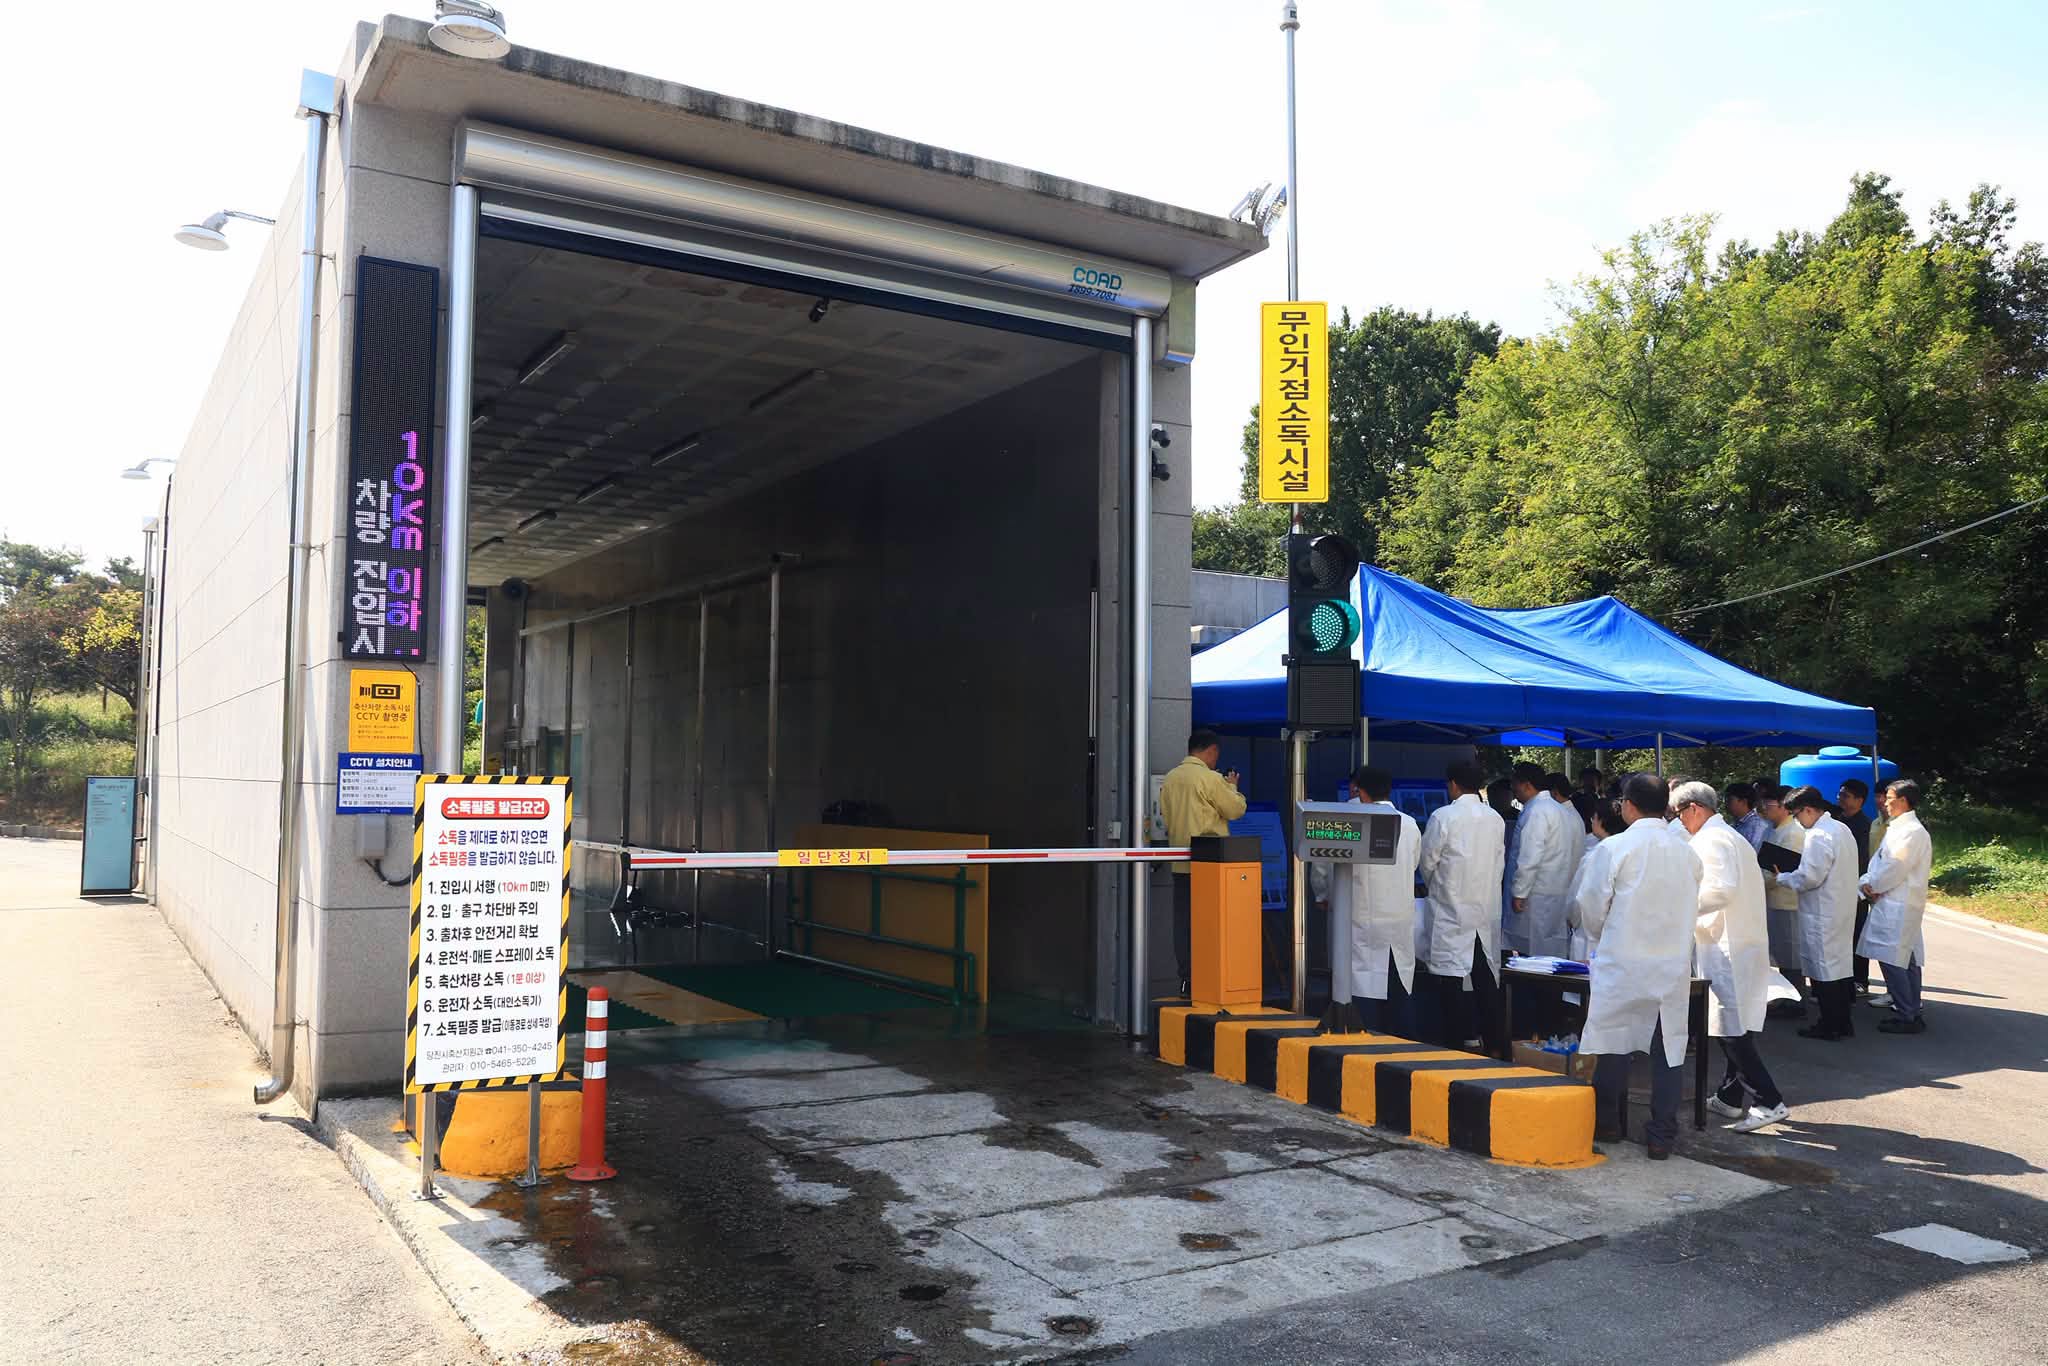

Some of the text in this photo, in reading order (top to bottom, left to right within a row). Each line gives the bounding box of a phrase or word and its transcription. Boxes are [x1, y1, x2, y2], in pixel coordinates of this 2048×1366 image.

[1073, 266, 1122, 290] COAD
[1278, 311, 1312, 492] 무인거점소독시설
[350, 478, 392, 654] 차량 진입시
[386, 567, 422, 631] 이하
[354, 703, 381, 712] 축산차량
[356, 712, 408, 722] CCTV 촬영중
[350, 757, 413, 768] CCTV 설치안내
[447, 800, 545, 815] 소독필증 발급요건
[438, 830, 548, 845] 소독을 제대로 하지 않으면
[429, 850, 557, 866] 소독필증을 발급하지 않습니다.
[797, 850, 871, 864] 일단정지
[428, 882, 437, 894] 1.
[440, 880, 471, 895] 진입시
[474, 880, 496, 894] 서행
[530, 880, 550, 893] 미만)
[427, 905, 438, 918] 2.
[485, 902, 516, 917] 차단바
[518, 901, 538, 917] 주의
[426, 924, 539, 942] 3. 출차후 안전거리 확보
[425, 952, 435, 965] 4.
[495, 947, 533, 963] 스프레이
[536, 946, 555, 961] 소독
[425, 976, 436, 989] 5.
[439, 973, 481, 989] 축산차량
[484, 972, 504, 987] 소독
[424, 1000, 435, 1013] 6.
[438, 997, 470, 1013] 운전자
[423, 1024, 434, 1037] 7.
[436, 1019, 478, 1037] 소독필증
[492, 1042, 552, 1056] 041-350-4245
[442, 1063, 464, 1073] 관리자
[470, 1057, 537, 1072] 010-5465-5226
